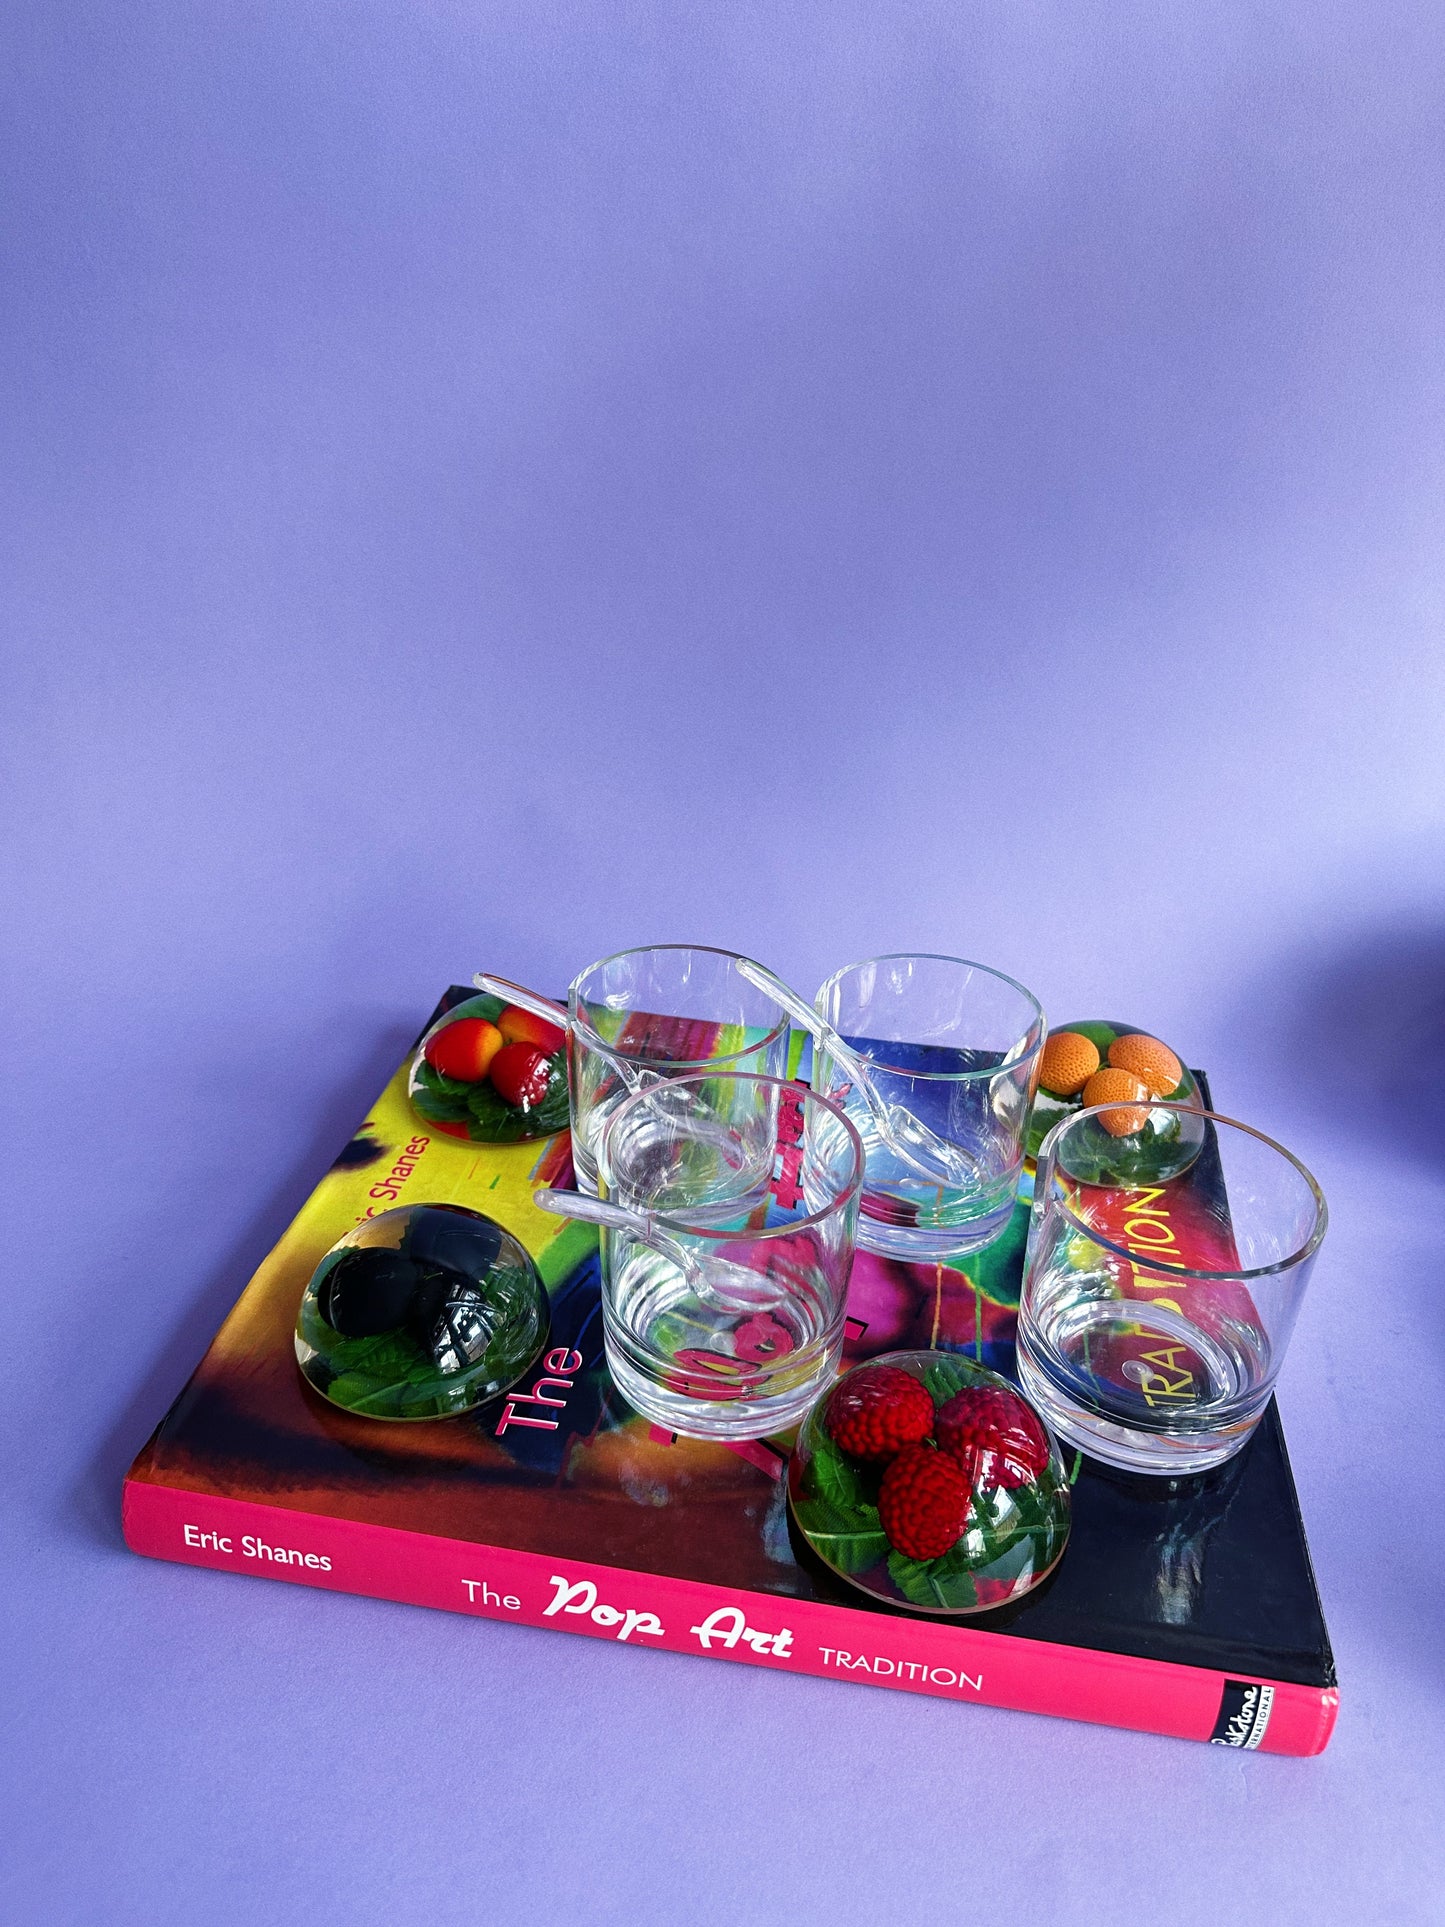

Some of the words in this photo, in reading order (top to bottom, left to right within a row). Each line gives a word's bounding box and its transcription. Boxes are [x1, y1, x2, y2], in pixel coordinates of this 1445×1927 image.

[369, 1135, 430, 1200] Shanes
[495, 1347, 583, 1436] The
[183, 1523, 234, 1555] Eric
[242, 1534, 333, 1572] Shanes
[461, 1579, 522, 1611] The
[542, 1575, 665, 1641] Pop
[690, 1606, 794, 1659] Art
[818, 1646, 984, 1692] TRADITION
